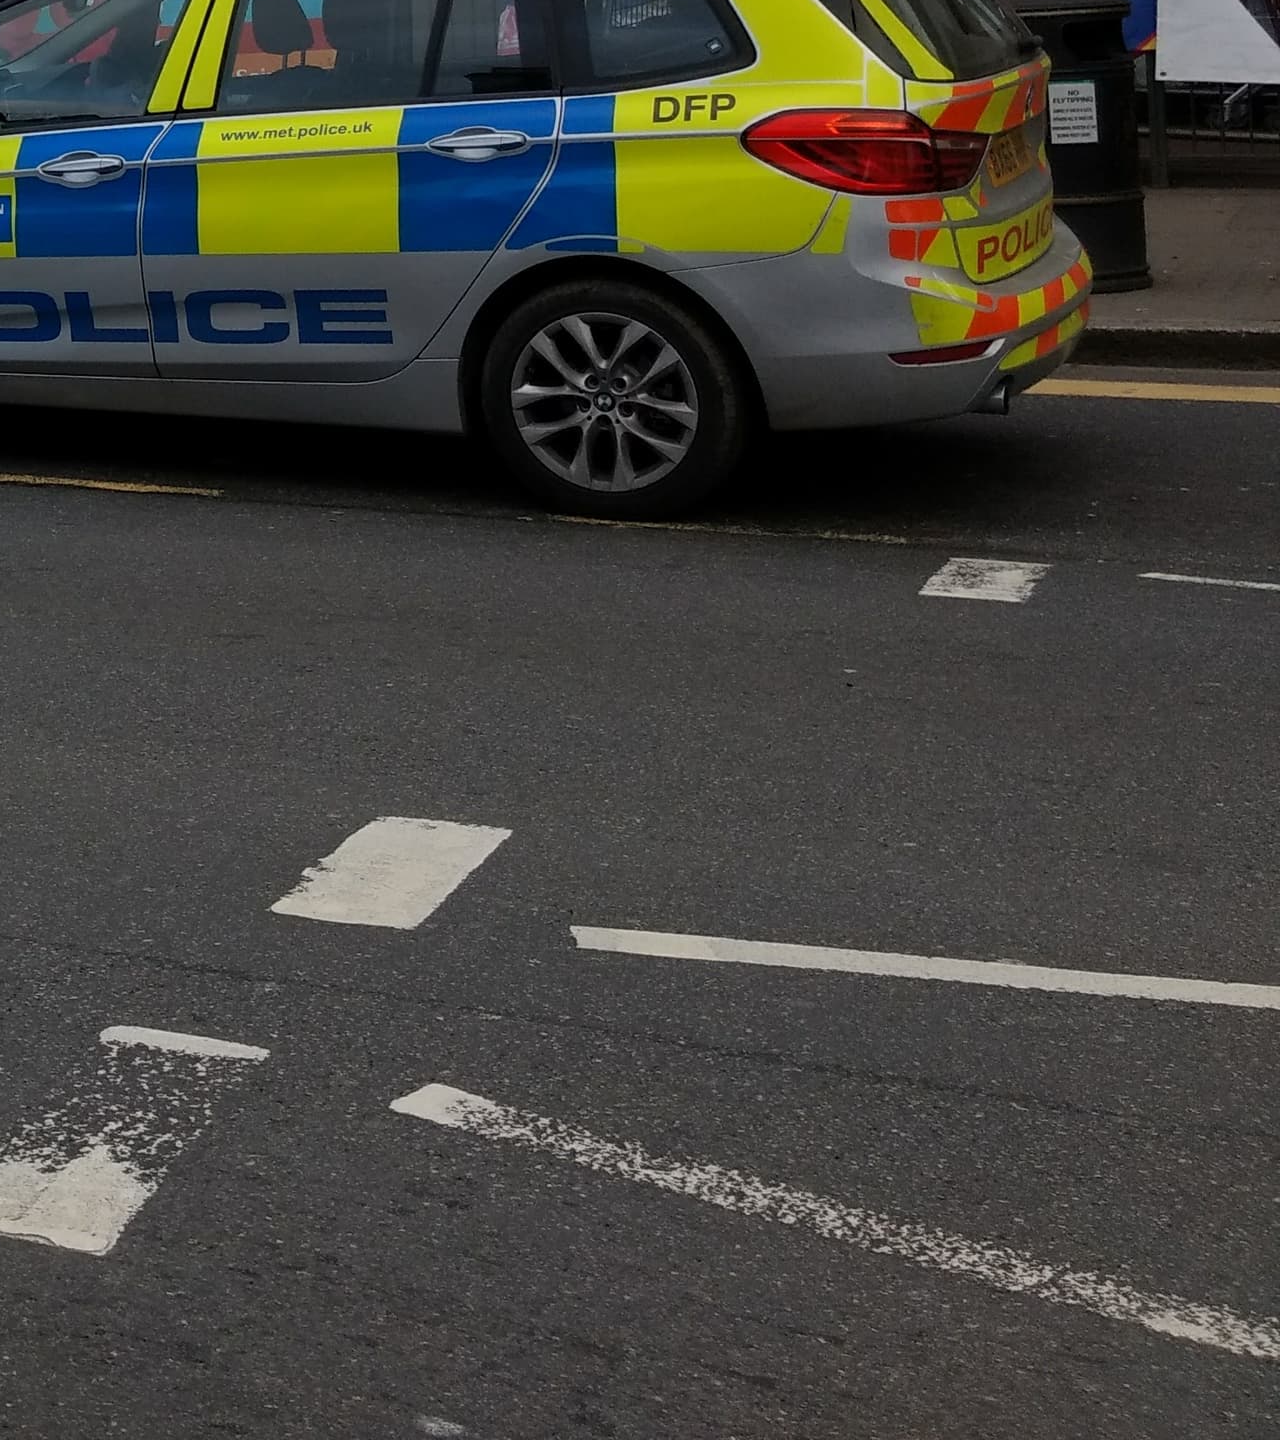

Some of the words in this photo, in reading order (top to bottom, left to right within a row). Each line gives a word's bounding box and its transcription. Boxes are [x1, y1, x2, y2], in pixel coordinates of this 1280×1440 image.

[651, 93, 737, 124] DFP
[220, 119, 373, 143] www.met.police.uk
[977, 203, 1053, 274] POLIC
